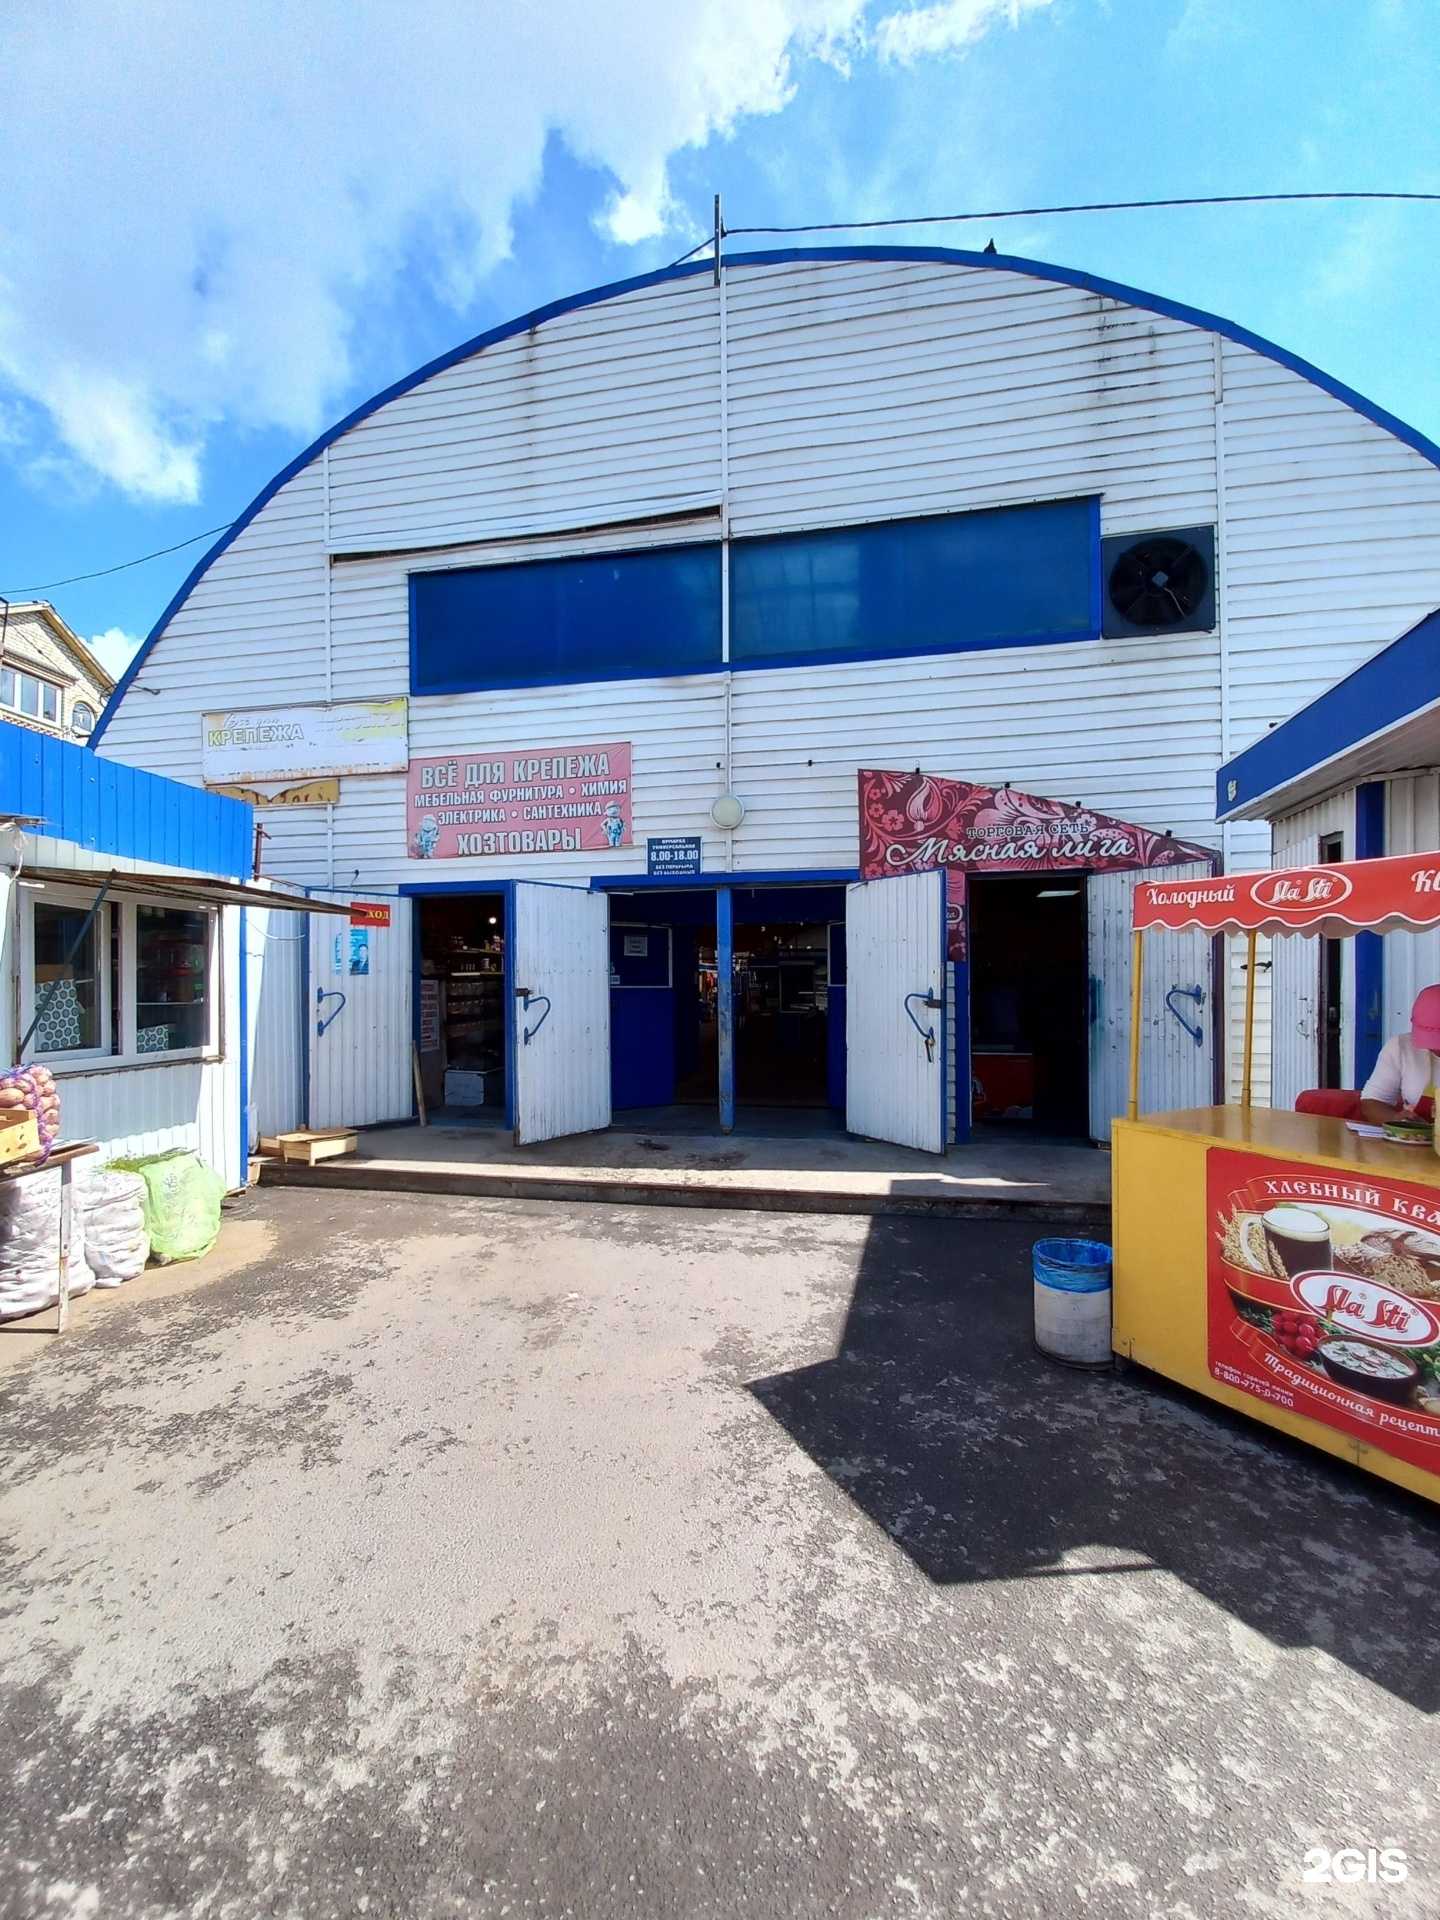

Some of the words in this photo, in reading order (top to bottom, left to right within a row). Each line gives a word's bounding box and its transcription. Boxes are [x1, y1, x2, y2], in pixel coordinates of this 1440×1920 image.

[208, 724, 304, 746] КРЕПЕЖА
[421, 760, 458, 788] ВСЁ
[464, 761, 506, 790] ДЛЯ
[512, 752, 610, 783] КРЕПЕЖА
[415, 789, 485, 808] МЕБЕЛЬНАЯ
[489, 784, 564, 804] ФУРНИТУРА
[581, 779, 627, 797] ХИМИЯ
[438, 808, 506, 825] ЭЛЕКТРИКА
[523, 801, 603, 821] САНТЕХНИКА
[456, 827, 583, 857] ХОЗТОВАРЫ
[966, 824, 1045, 839] ТОРГОВАЯ
[1048, 822, 1090, 836] СЕТЬ
[650, 850, 698, 861] 8.00-18.00
[886, 837, 1048, 867] Мясная
[1050, 837, 1136, 858] лига
[1146, 884, 1236, 909] Холодный
[366, 910, 389, 920] ХОД
[1264, 1180, 1381, 1206] ХЛЕБНЫЙ
[1391, 1197, 1440, 1226] КВА
[1214, 1367, 1294, 1407] 8-800-775-0-700
[1264, 1352, 1376, 1418] Традиционная
